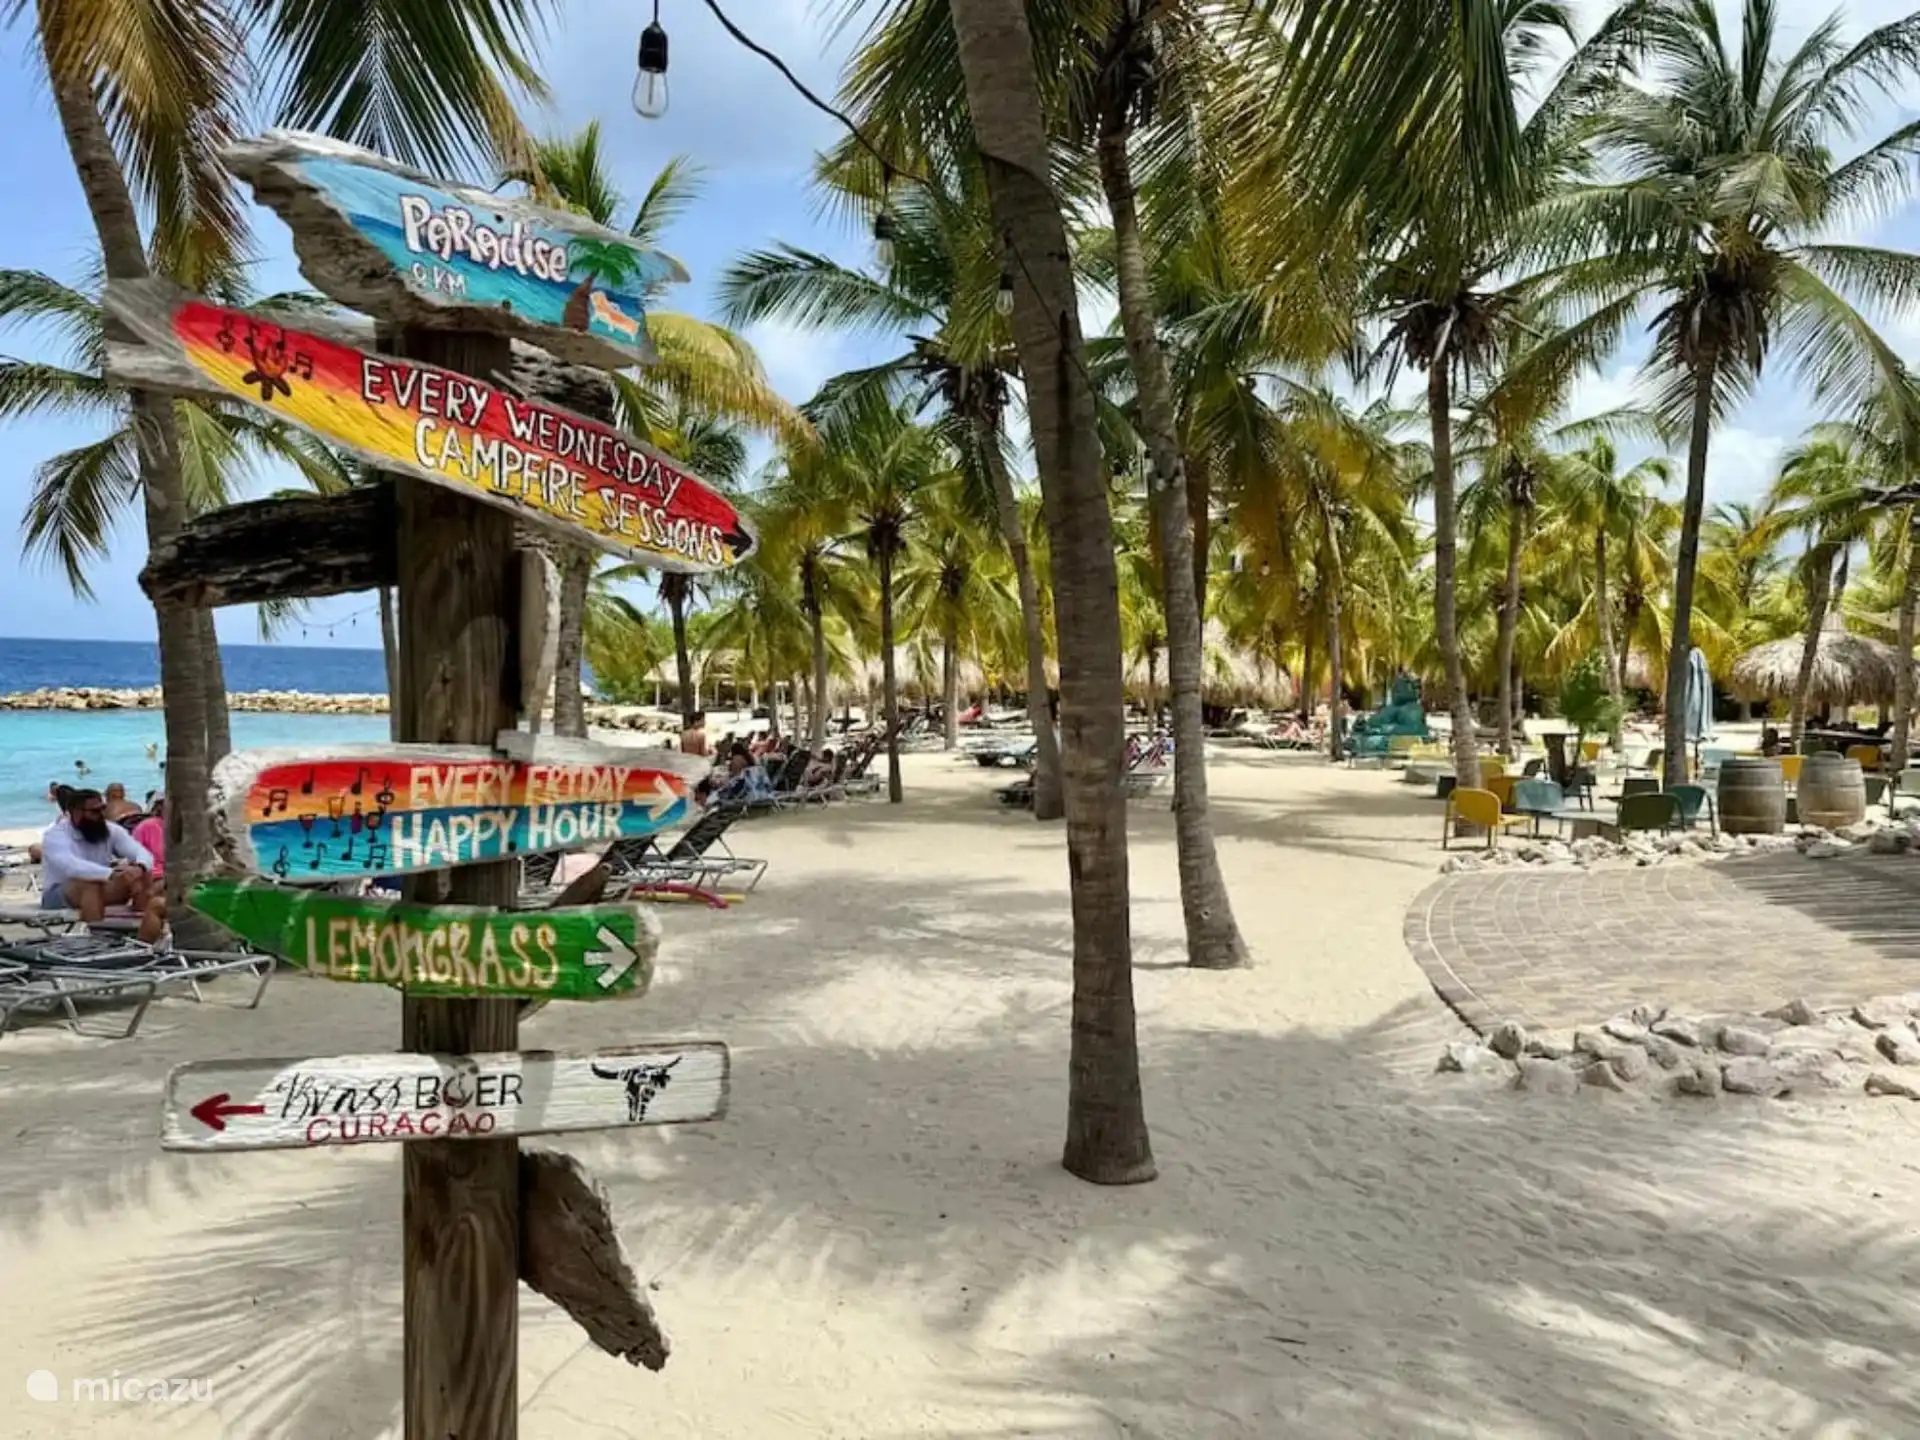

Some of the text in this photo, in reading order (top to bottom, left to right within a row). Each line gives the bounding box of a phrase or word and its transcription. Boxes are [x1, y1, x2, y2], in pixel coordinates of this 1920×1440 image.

[364, 359, 681, 506] EVERY WEDNESDAY
[415, 417, 723, 564] CAMPFIRE SESSIONS
[409, 764, 630, 808] EVERY FRIDAY
[391, 811, 517, 868] HAPPY
[305, 915, 560, 990] LEMONGRASS
[416, 1073, 524, 1110] BOER
[306, 1111, 496, 1145] CURACAO
